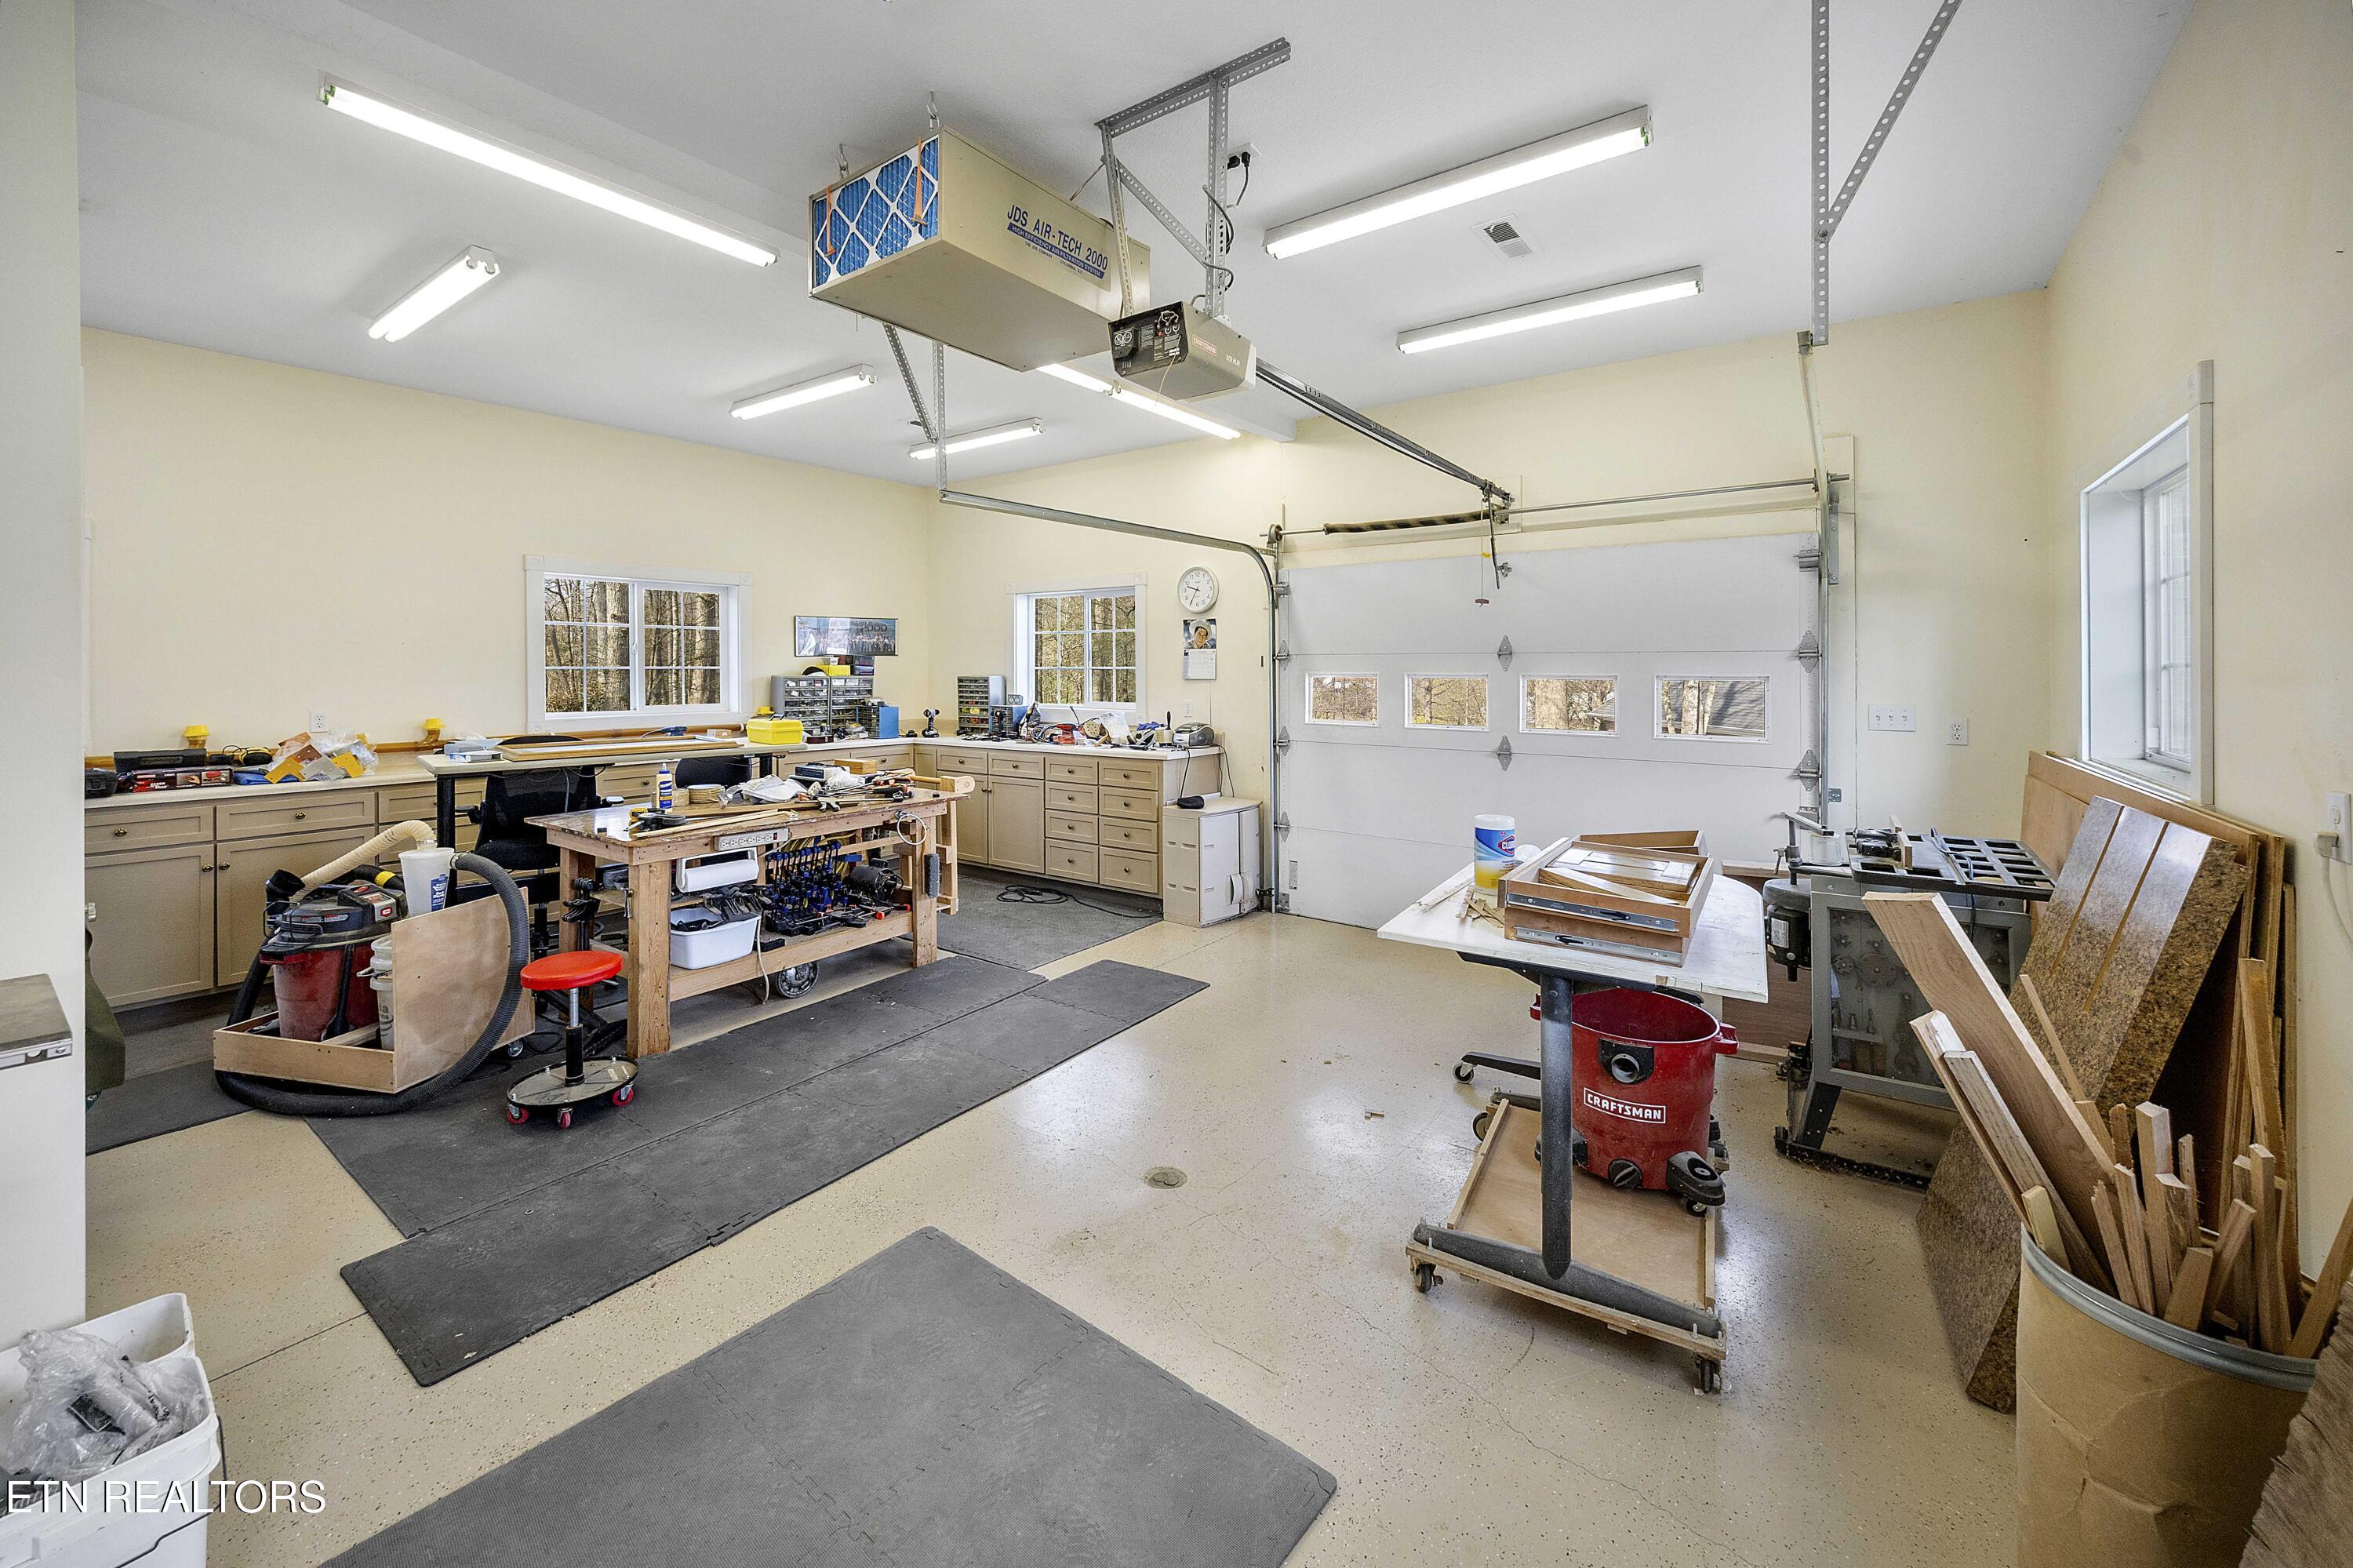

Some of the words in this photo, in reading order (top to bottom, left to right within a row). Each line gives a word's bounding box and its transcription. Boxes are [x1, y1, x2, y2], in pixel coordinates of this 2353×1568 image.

[1007, 205, 1028, 227] JDS
[1033, 218, 1082, 256] AIR-TECH
[1086, 247, 1108, 271] 2000
[1012, 225, 1024, 236] HIGH
[1024, 232, 1051, 250] EFFICIENCY
[1052, 246, 1060, 256] AIR
[1060, 250, 1084, 268] FILTRATION
[1084, 264, 1101, 277] SYSTEM
[1587, 1093, 1662, 1120] CRAFTSMAN
